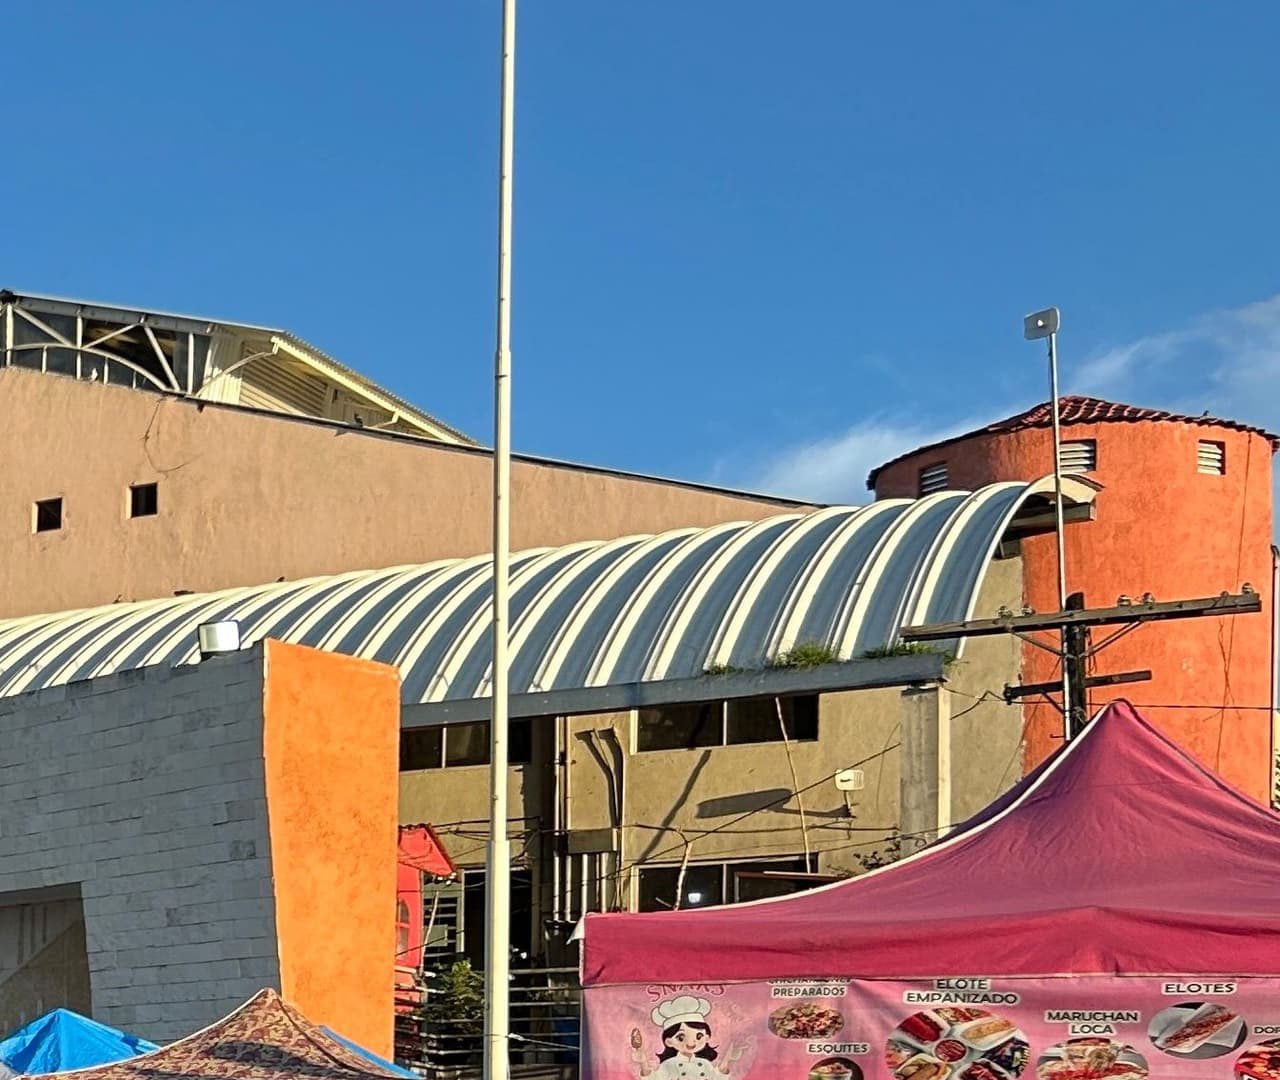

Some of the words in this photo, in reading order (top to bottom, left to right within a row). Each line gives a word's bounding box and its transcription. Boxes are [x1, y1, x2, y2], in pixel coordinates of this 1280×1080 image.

[936, 979, 987, 989] ELOTE
[1164, 983, 1235, 993] ELOTES
[773, 987, 845, 997] PREPARADOS
[906, 992, 1018, 1004] EMPANIZADO
[1047, 1011, 1138, 1021] MARUCHAN
[1071, 1024, 1114, 1034] LOCA
[808, 1043, 868, 1054] ESQUITES
